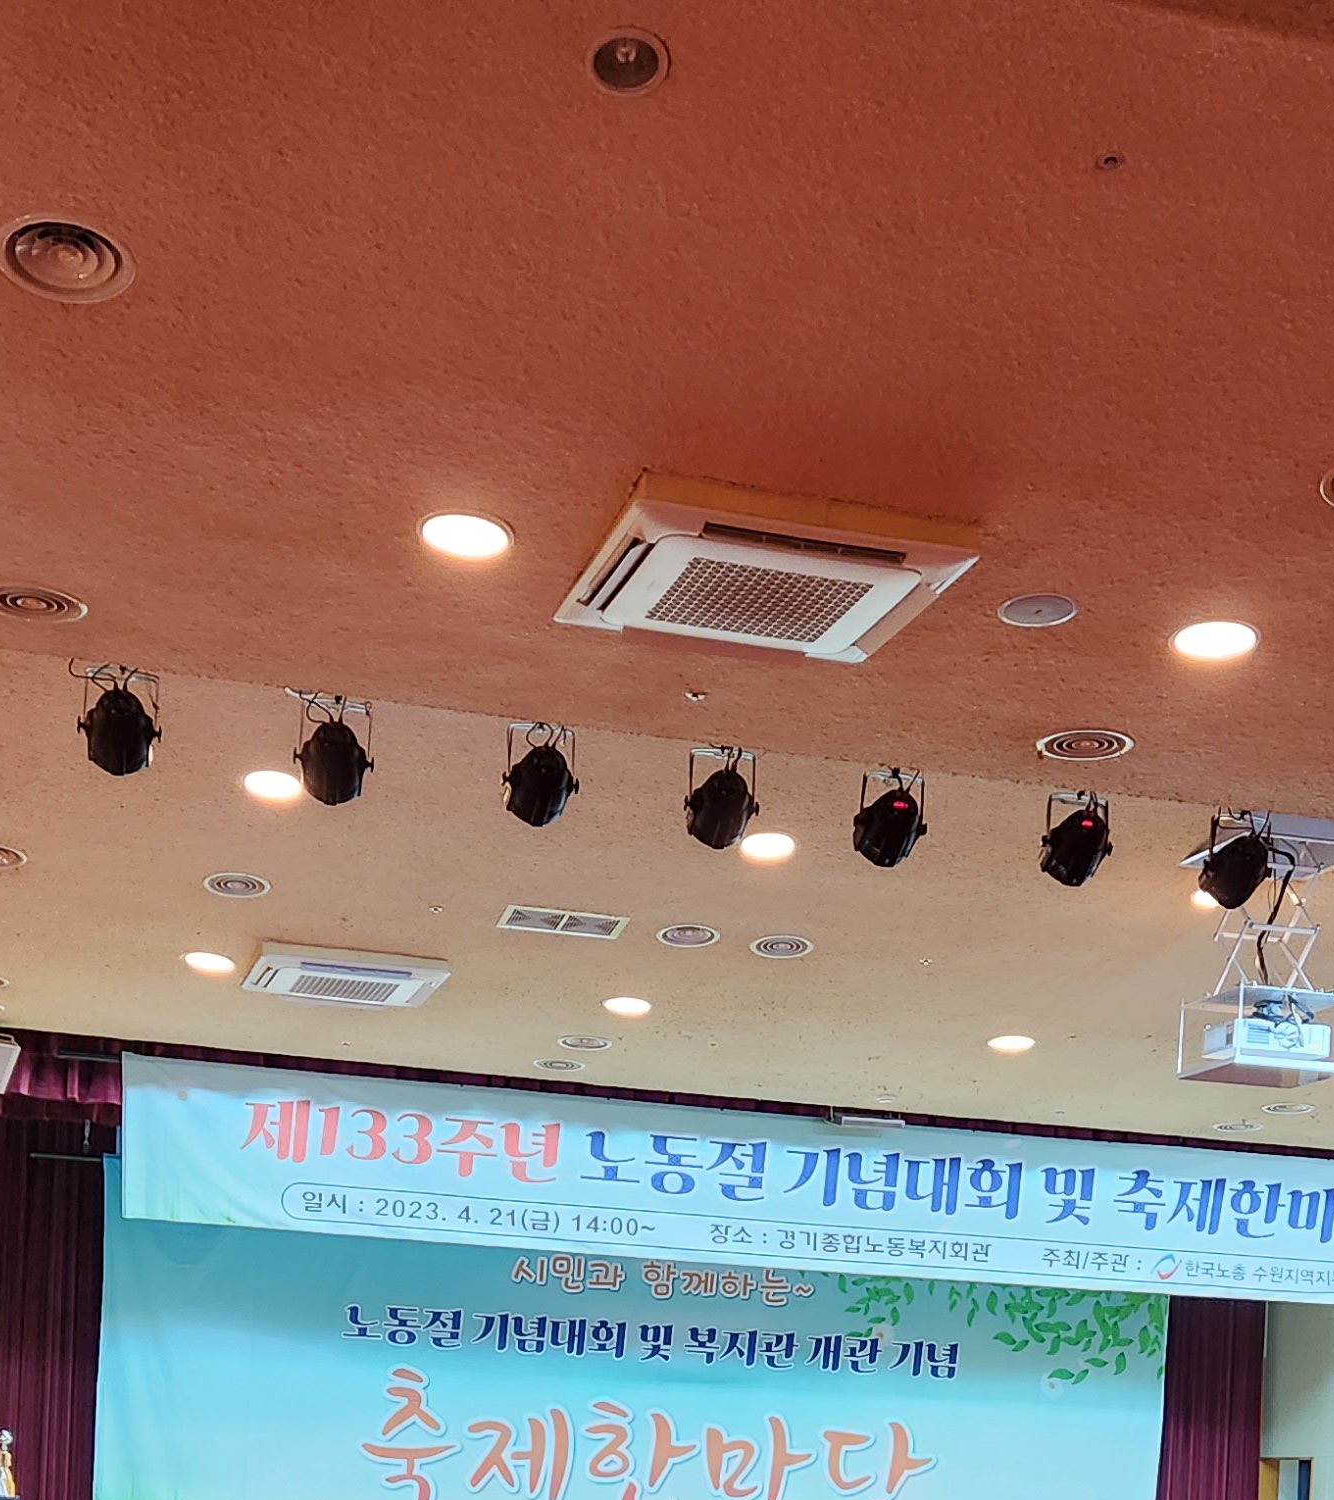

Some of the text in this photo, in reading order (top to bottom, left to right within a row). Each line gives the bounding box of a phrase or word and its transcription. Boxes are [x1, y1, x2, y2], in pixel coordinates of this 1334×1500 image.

[240, 1099, 561, 1184] 제133주년
[580, 1129, 767, 1202] 노동절
[783, 1147, 1023, 1220] 기념대회
[1040, 1166, 1096, 1226] 및
[301, 1191, 347, 1215] 일시
[375, 1197, 448, 1222] 2023.
[456, 1204, 480, 1225] 4.
[488, 1207, 561, 1234] 21(금)
[571, 1214, 657, 1237] 14:00~
[709, 1222, 754, 1246] 장소
[775, 1229, 993, 1263] 경기종합노동복지회관
[1041, 1247, 1130, 1274] 주최/주관
[1184, 1258, 1247, 1282] 한국노총
[512, 1253, 816, 1305] 시민과 함께하는~
[342, 1303, 960, 1379] 노동절 기념대회 및 복지관 개관 기념
